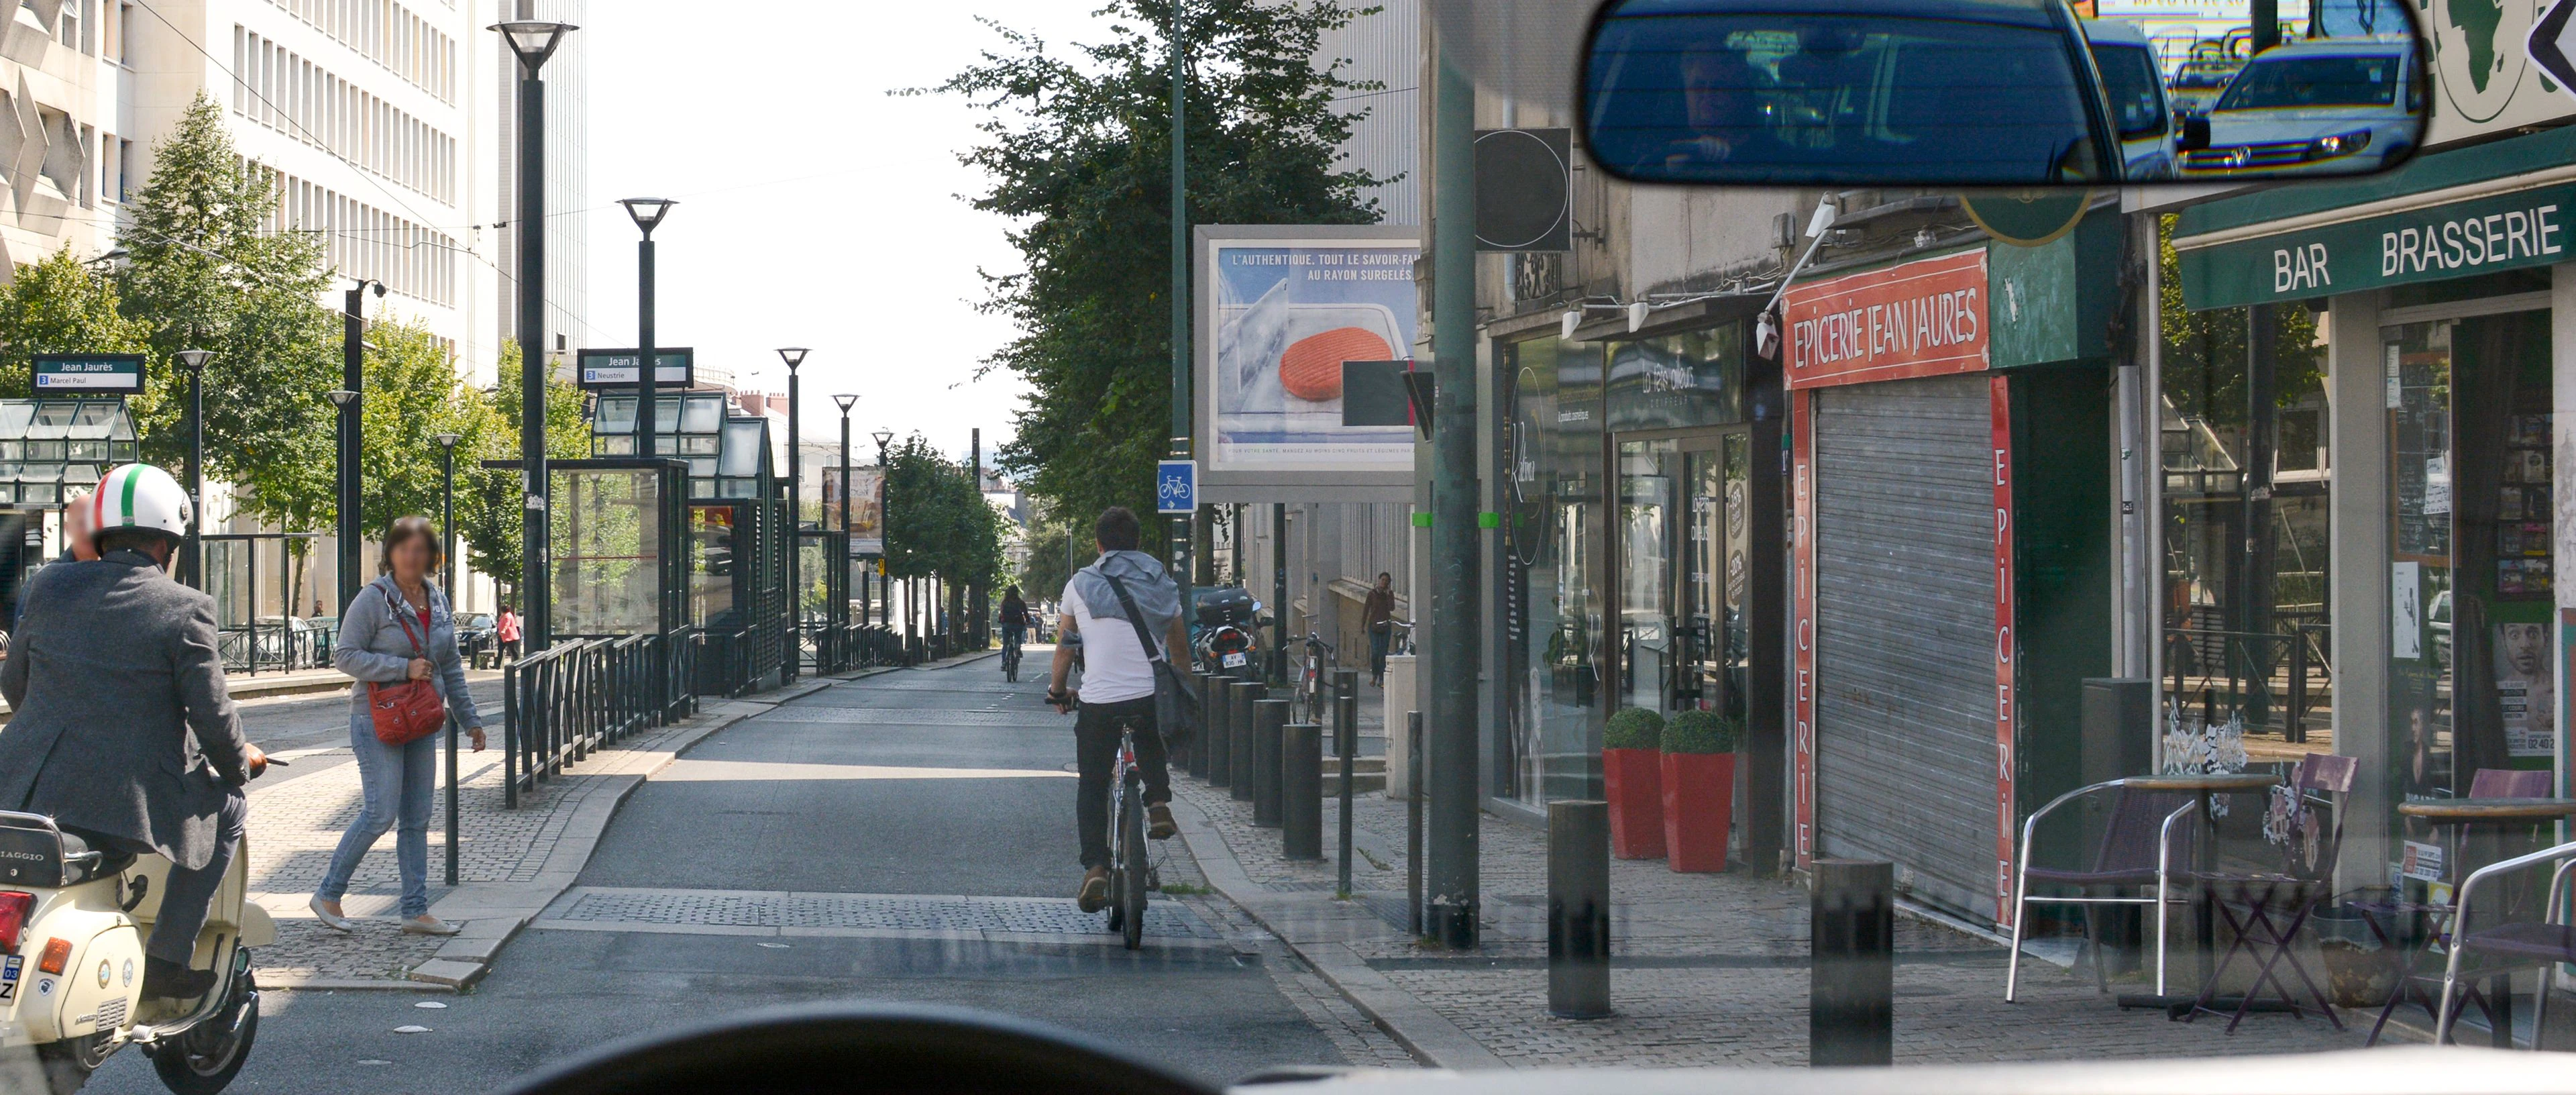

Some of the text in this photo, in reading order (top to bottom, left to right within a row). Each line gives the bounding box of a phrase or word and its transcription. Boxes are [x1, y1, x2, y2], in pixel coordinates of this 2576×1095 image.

[2275, 204, 2562, 293] BAR BRASSERIE
[1232, 254, 1421, 266] L'AUTHENTIQUE. TOUT LE SAVOIR-FAI
[1308, 270, 1320, 280] AU
[1324, 270, 1357, 280] RAYON
[1867, 301, 1909, 362] JEAN
[1912, 286, 1978, 356] JAURES
[608, 356, 661, 366] Jean Jas
[61, 362, 113, 372] Jean Jaurès
[2528, 739, 2538, 749] 02
[2539, 739, 2549, 749] 40
[0, 851, 44, 861] IAGGIO
[5, 969, 17, 978] 03
